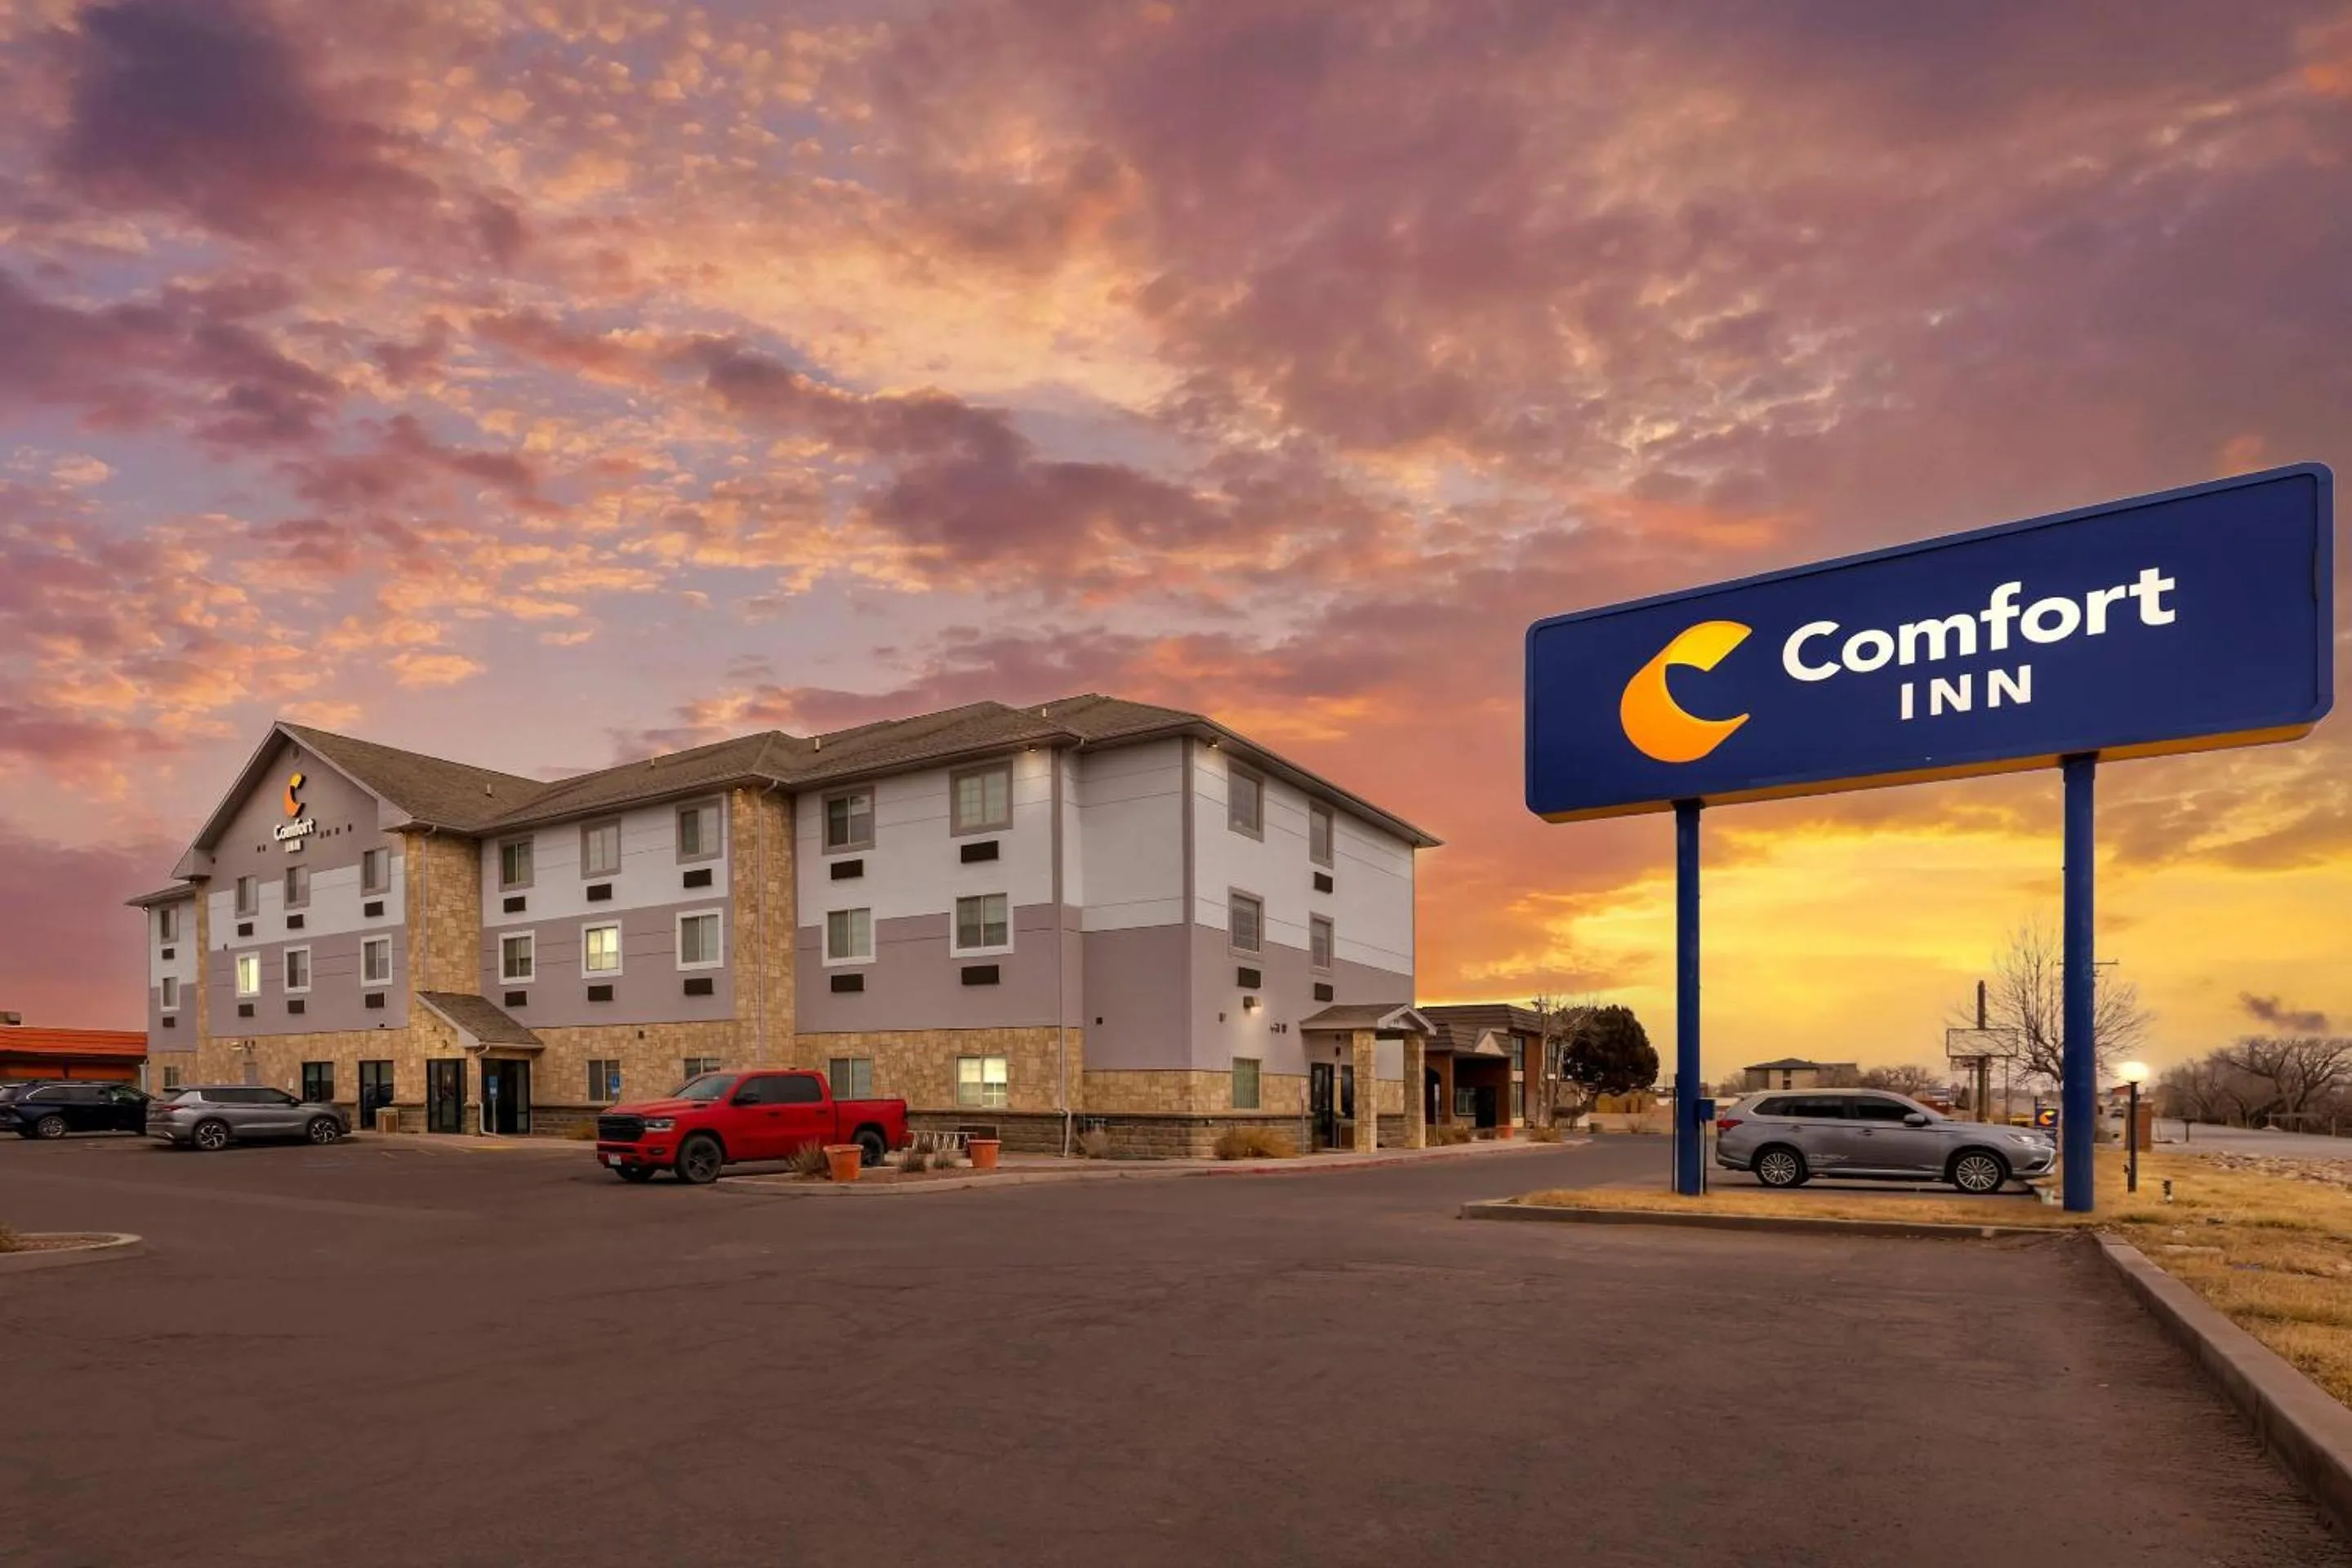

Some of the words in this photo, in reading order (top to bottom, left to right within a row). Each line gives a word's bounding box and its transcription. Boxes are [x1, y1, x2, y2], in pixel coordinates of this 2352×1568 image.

[1782, 568, 2176, 682] Comfort
[1901, 665, 2032, 720] INN
[274, 817, 314, 841] Comfort
